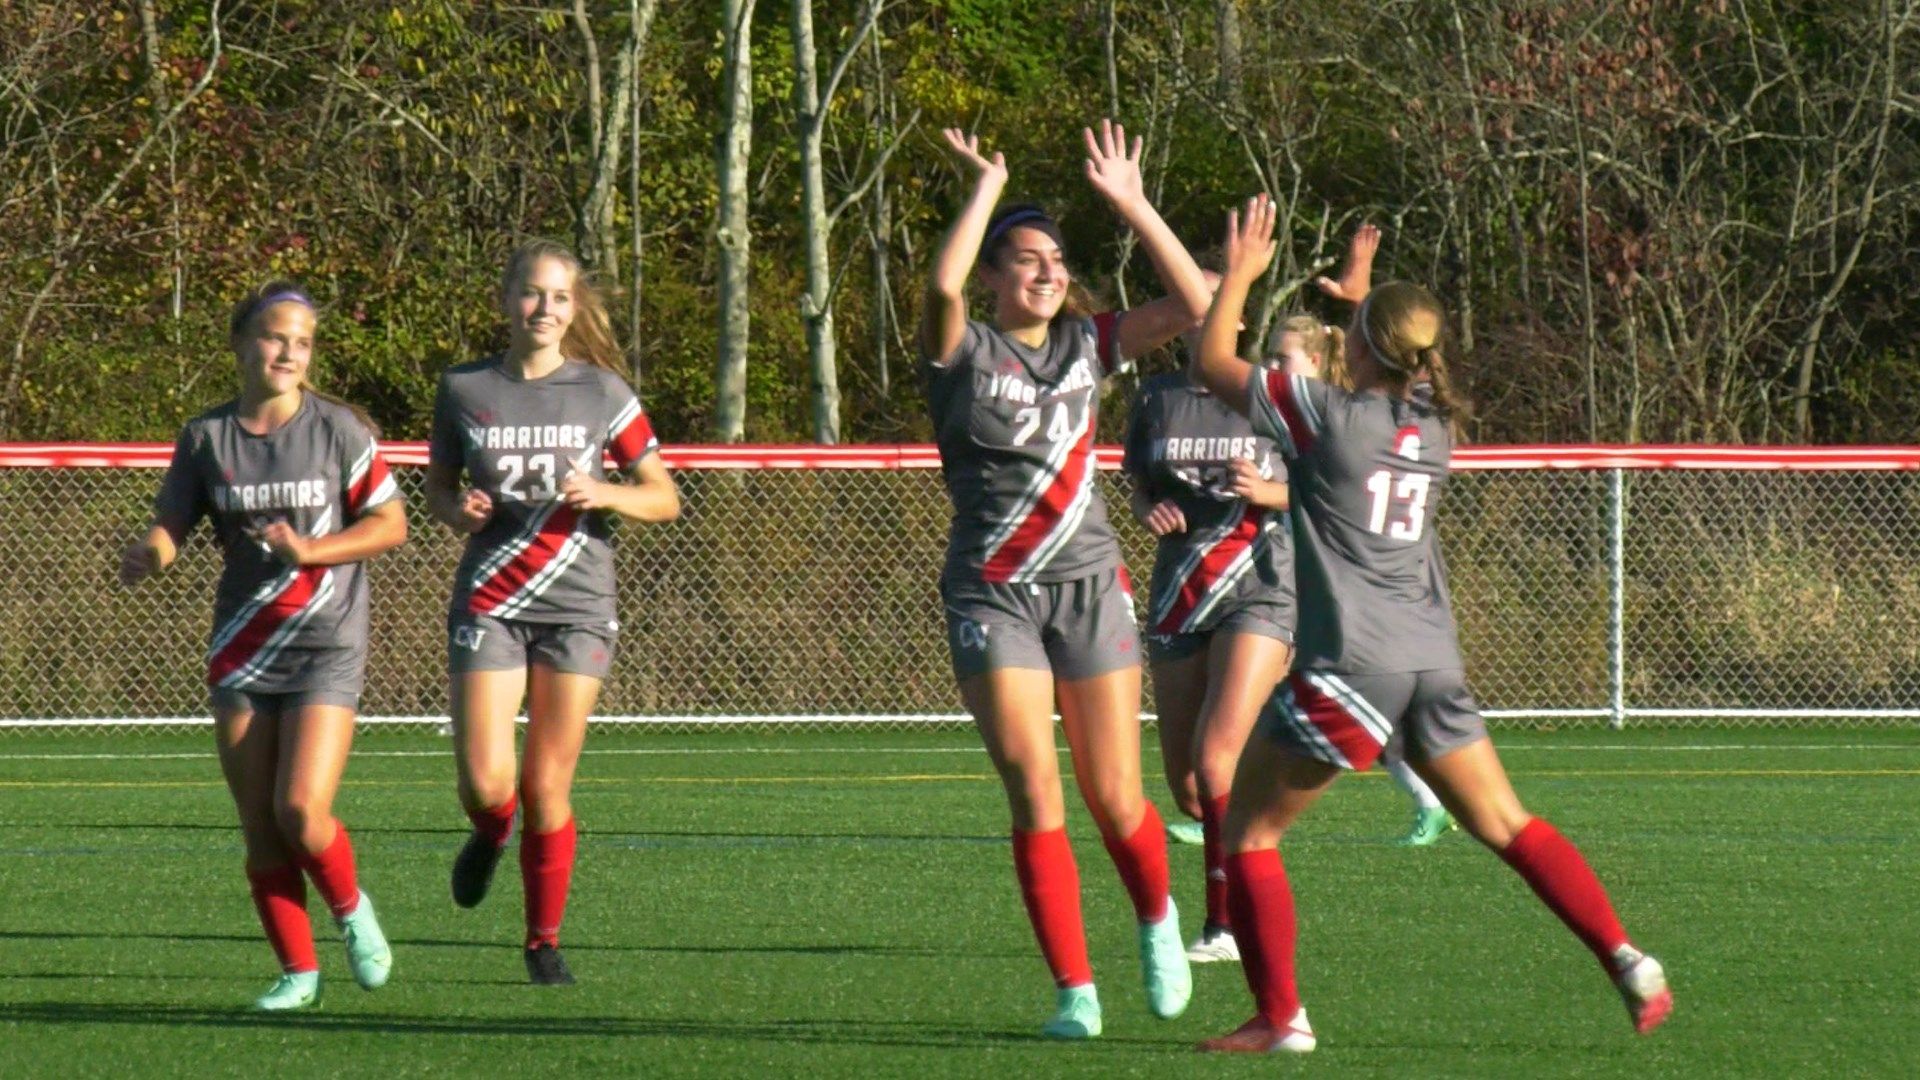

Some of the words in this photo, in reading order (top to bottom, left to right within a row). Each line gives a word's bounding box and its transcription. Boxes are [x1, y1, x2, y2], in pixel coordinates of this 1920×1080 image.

[468, 424, 587, 450] WARRIORS
[1013, 401, 1073, 447] 24
[1152, 436, 1257, 461] WARRIORS
[497, 453, 556, 501] 23
[1367, 470, 1431, 541] 13
[455, 626, 486, 652] CV
